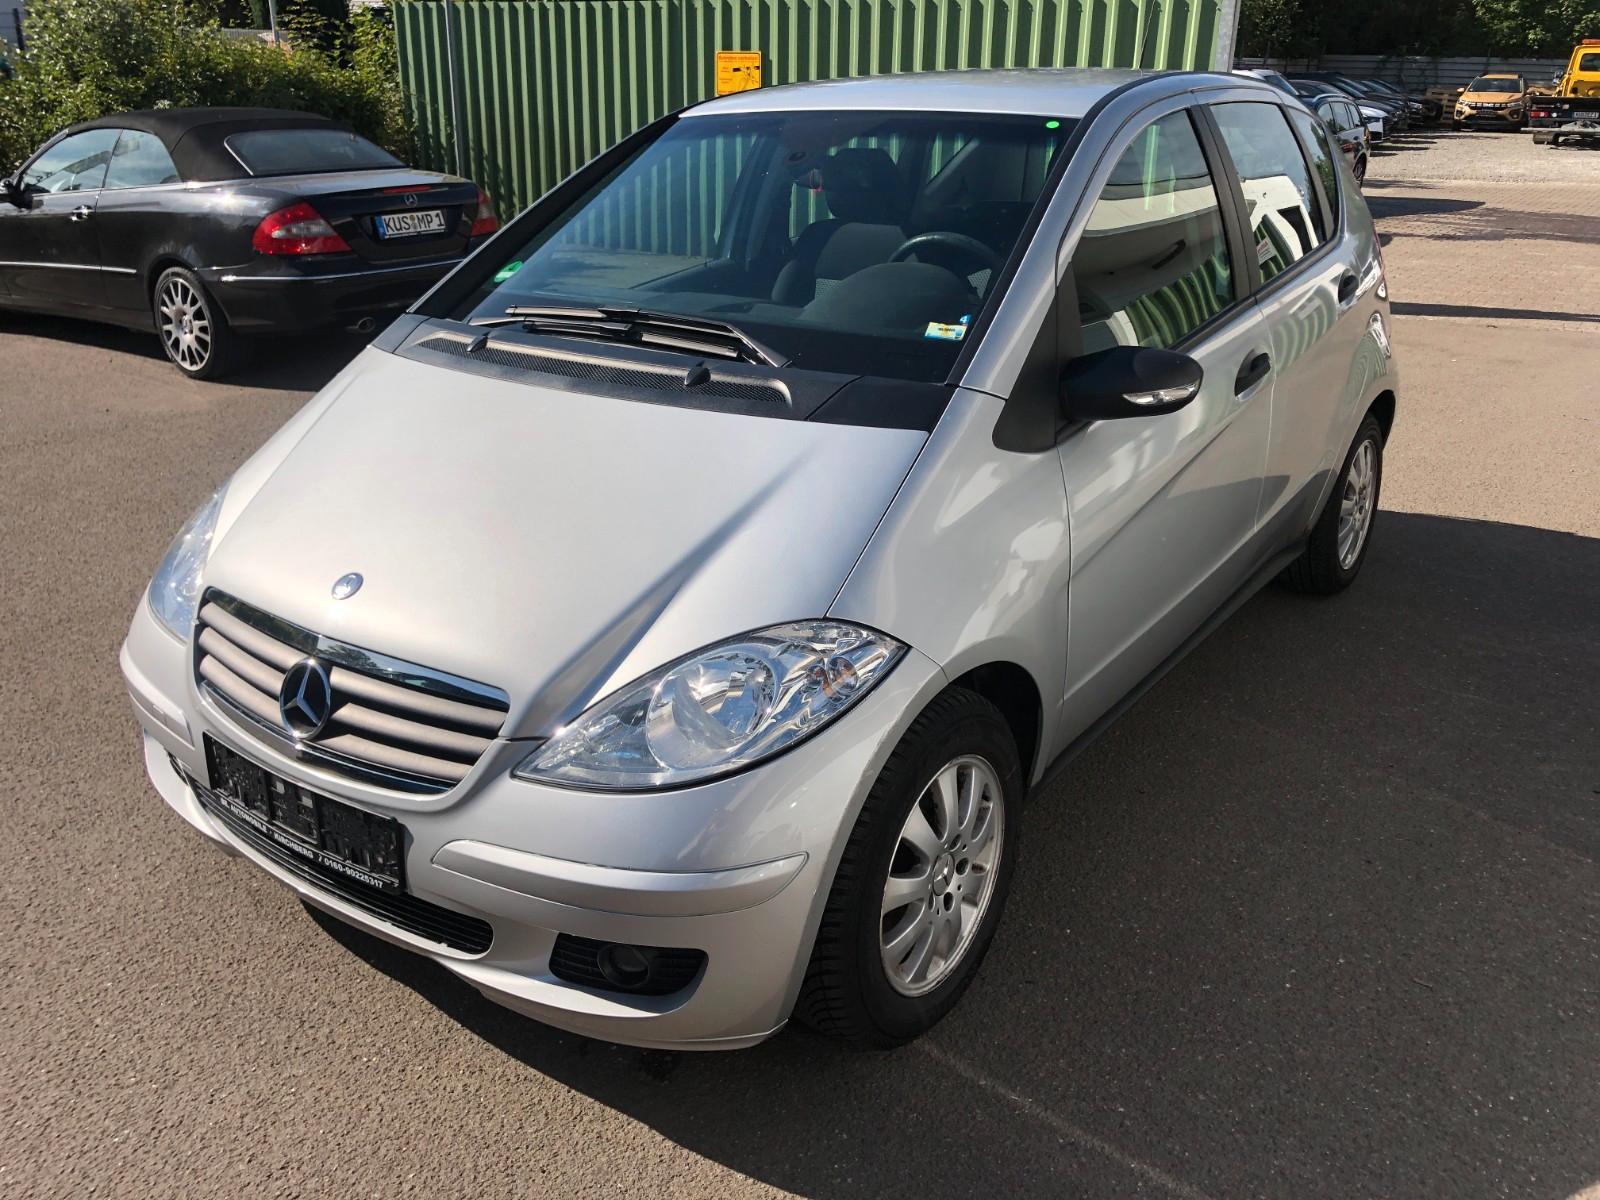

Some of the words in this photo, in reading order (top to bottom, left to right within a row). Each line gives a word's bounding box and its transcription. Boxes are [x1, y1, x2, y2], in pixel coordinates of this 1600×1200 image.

[383, 216, 411, 233] KUS
[416, 213, 433, 229] MP
[435, 212, 444, 227] 1
[231, 803, 268, 834] AUTOMOBILE
[273, 831, 314, 858] KIRCHBERG
